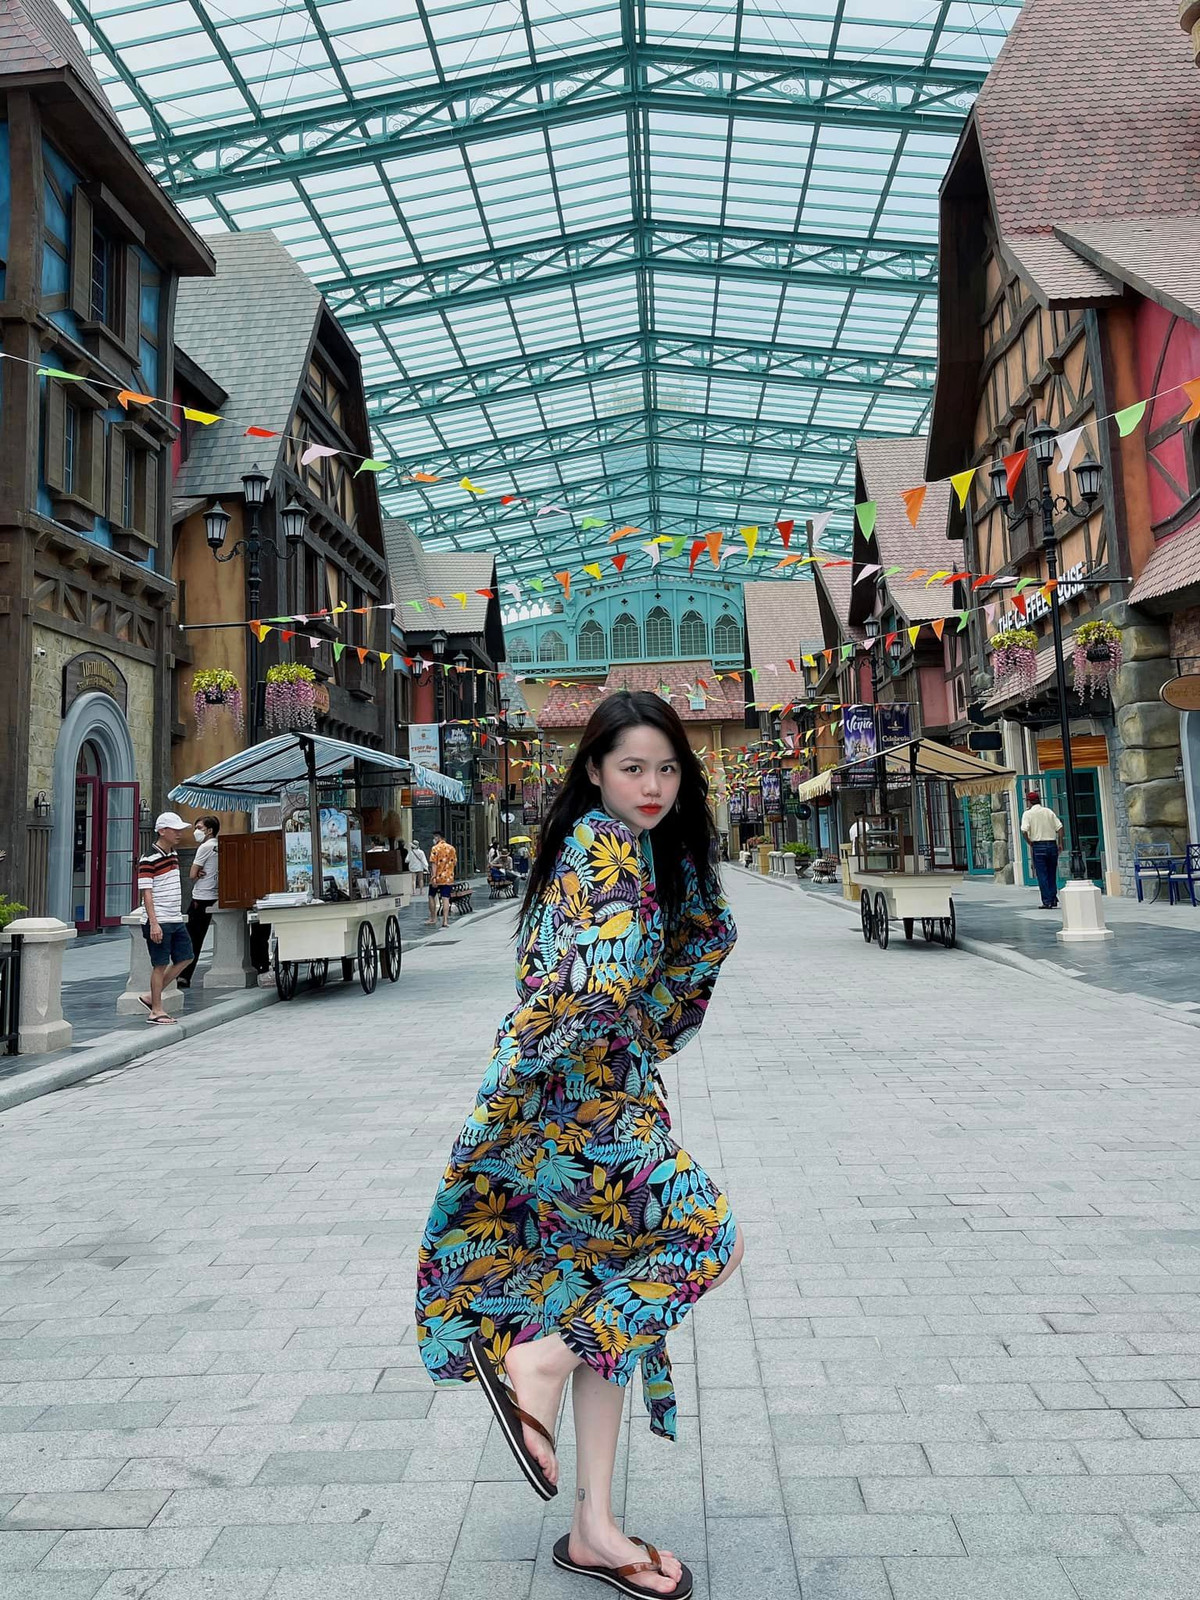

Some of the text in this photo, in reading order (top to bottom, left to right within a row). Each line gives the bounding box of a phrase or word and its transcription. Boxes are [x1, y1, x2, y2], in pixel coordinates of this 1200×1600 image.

[999, 610, 1014, 634] THE
[1057, 561, 1085, 605] OUSE
[846, 714, 873, 734] Venice
